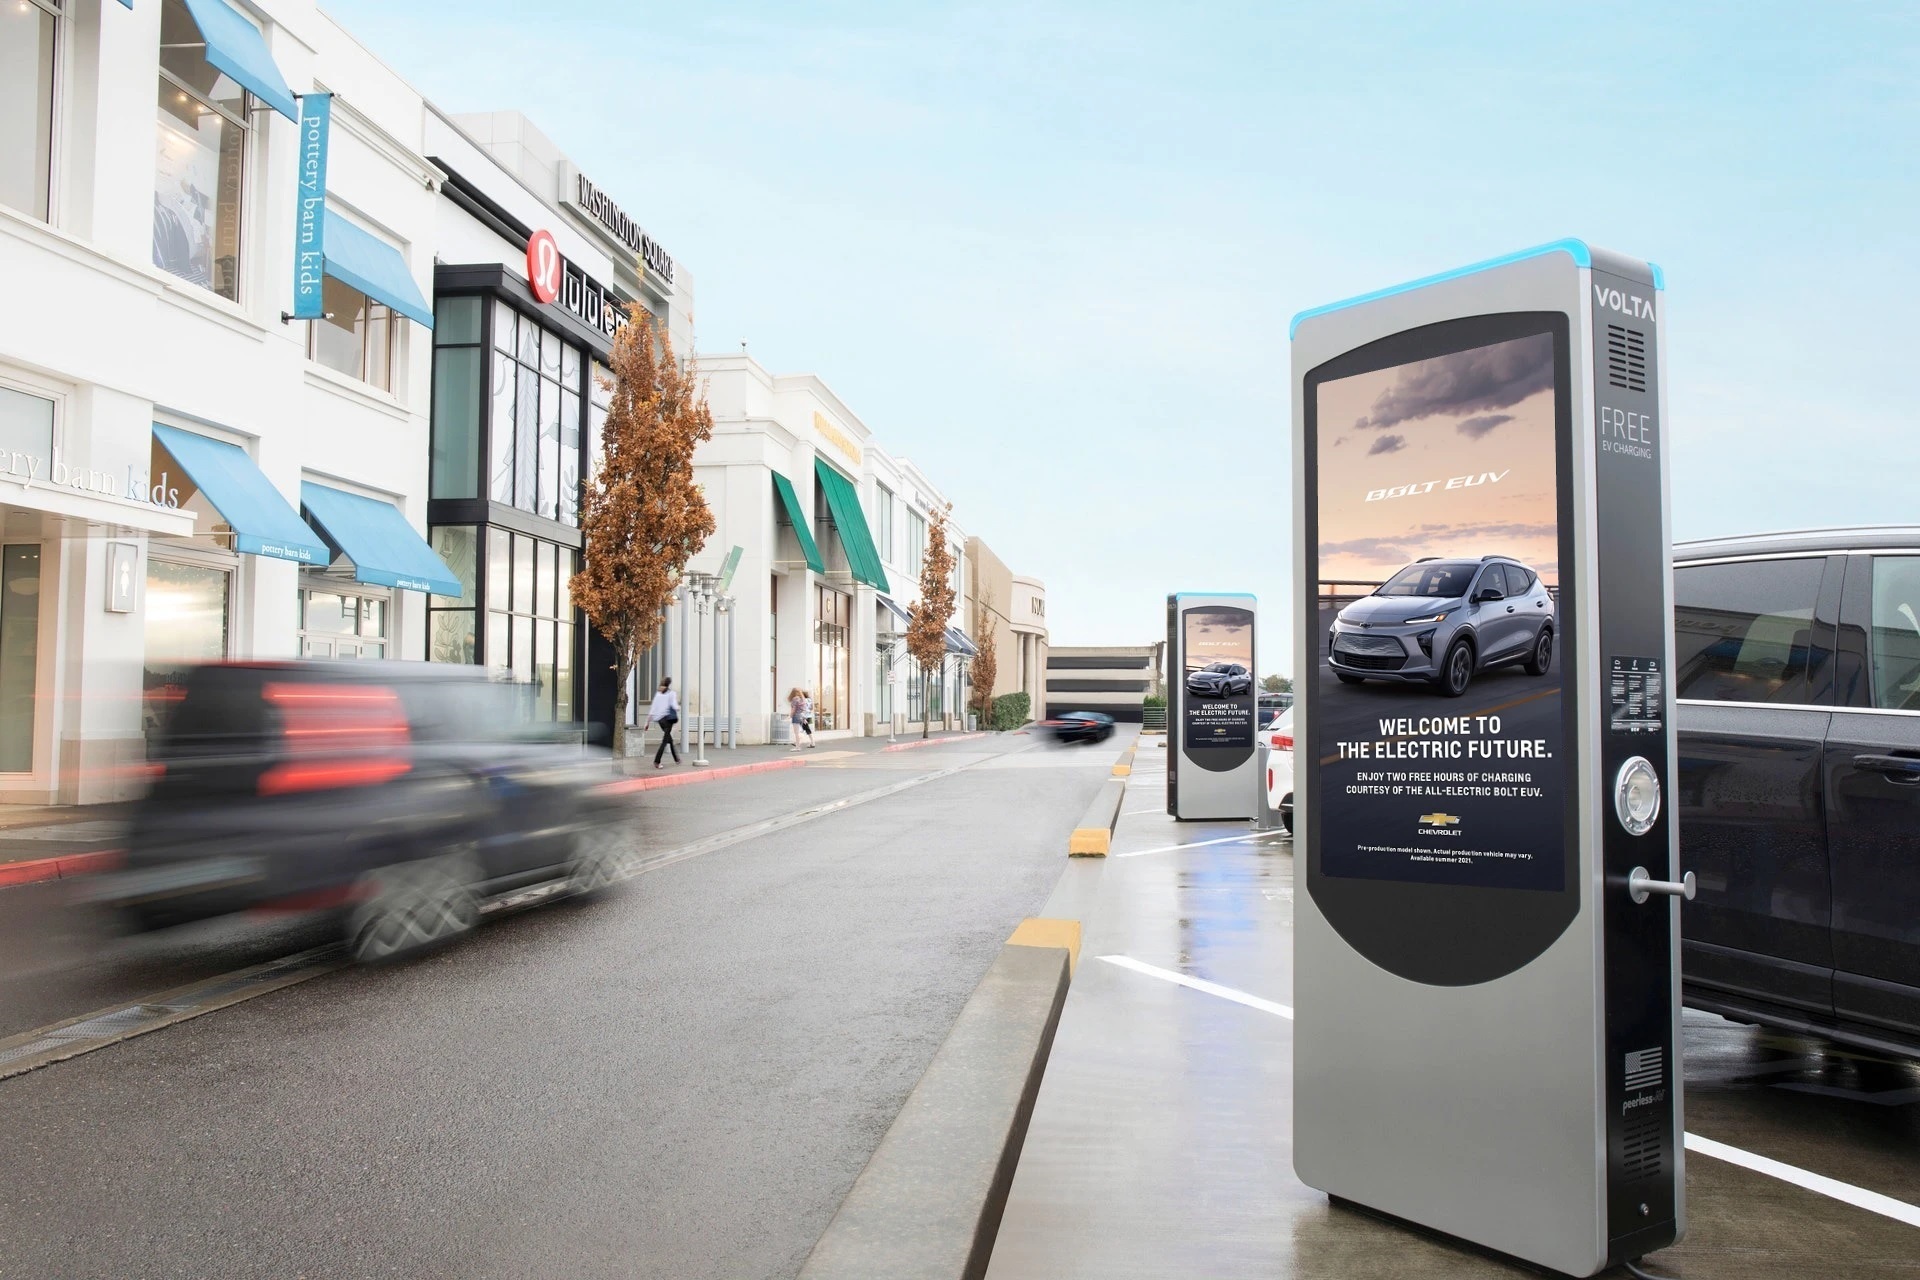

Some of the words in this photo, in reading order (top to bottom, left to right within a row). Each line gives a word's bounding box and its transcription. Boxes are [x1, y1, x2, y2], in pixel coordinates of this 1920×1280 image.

[300, 116, 320, 191] pottery
[302, 196, 322, 243] barn
[578, 173, 641, 254] WASHINGTON
[642, 234, 674, 285] SQUARE
[300, 251, 320, 295] kids
[563, 258, 629, 338] lululem
[1594, 284, 1656, 322] VOLTA
[1602, 406, 1651, 445] FREE
[1602, 440, 1612, 451] EV
[1613, 442, 1652, 459] CHARGING
[52, 447, 116, 496] barn
[125, 463, 179, 509] kids
[1364, 480, 1441, 502] BOLT
[1444, 469, 1511, 490] EUV
[262, 544, 284, 557] pottery
[284, 545, 298, 558] barn
[298, 549, 311, 560] kids
[1379, 717, 1471, 735] WELCOME
[1476, 716, 1501, 734] TO
[1337, 742, 1370, 759] THE
[1375, 740, 1462, 759] ELECTRIC
[1468, 740, 1553, 758] FUTURE.
[1357, 772, 1385, 782] ENJOY
[1386, 772, 1407, 782] TWO
[1409, 772, 1432, 782] FREE
[1433, 772, 1465, 782] HOURS
[1466, 773, 1479, 782] OF
[1481, 773, 1532, 783] CHARGING
[1346, 785, 1390, 795] COURTESY
[1392, 785, 1404, 795] OF
[1405, 786, 1423, 795] THE
[1425, 786, 1491, 796] ALL-ELECTRIC
[1493, 786, 1518, 797] BOLT
[1520, 788, 1543, 797] EUV.
[1418, 828, 1462, 836] CHEVROLET
[1357, 844, 1396, 853] Pre-production
[1397, 846, 1413, 854] model
[1413, 847, 1433, 855] shown.
[1451, 849, 1483, 857] production
[1483, 850, 1504, 858] vehicle
[1504, 852, 1517, 860] may
[1518, 853, 1534, 861] vary.
[1410, 854, 1435, 862] Available
